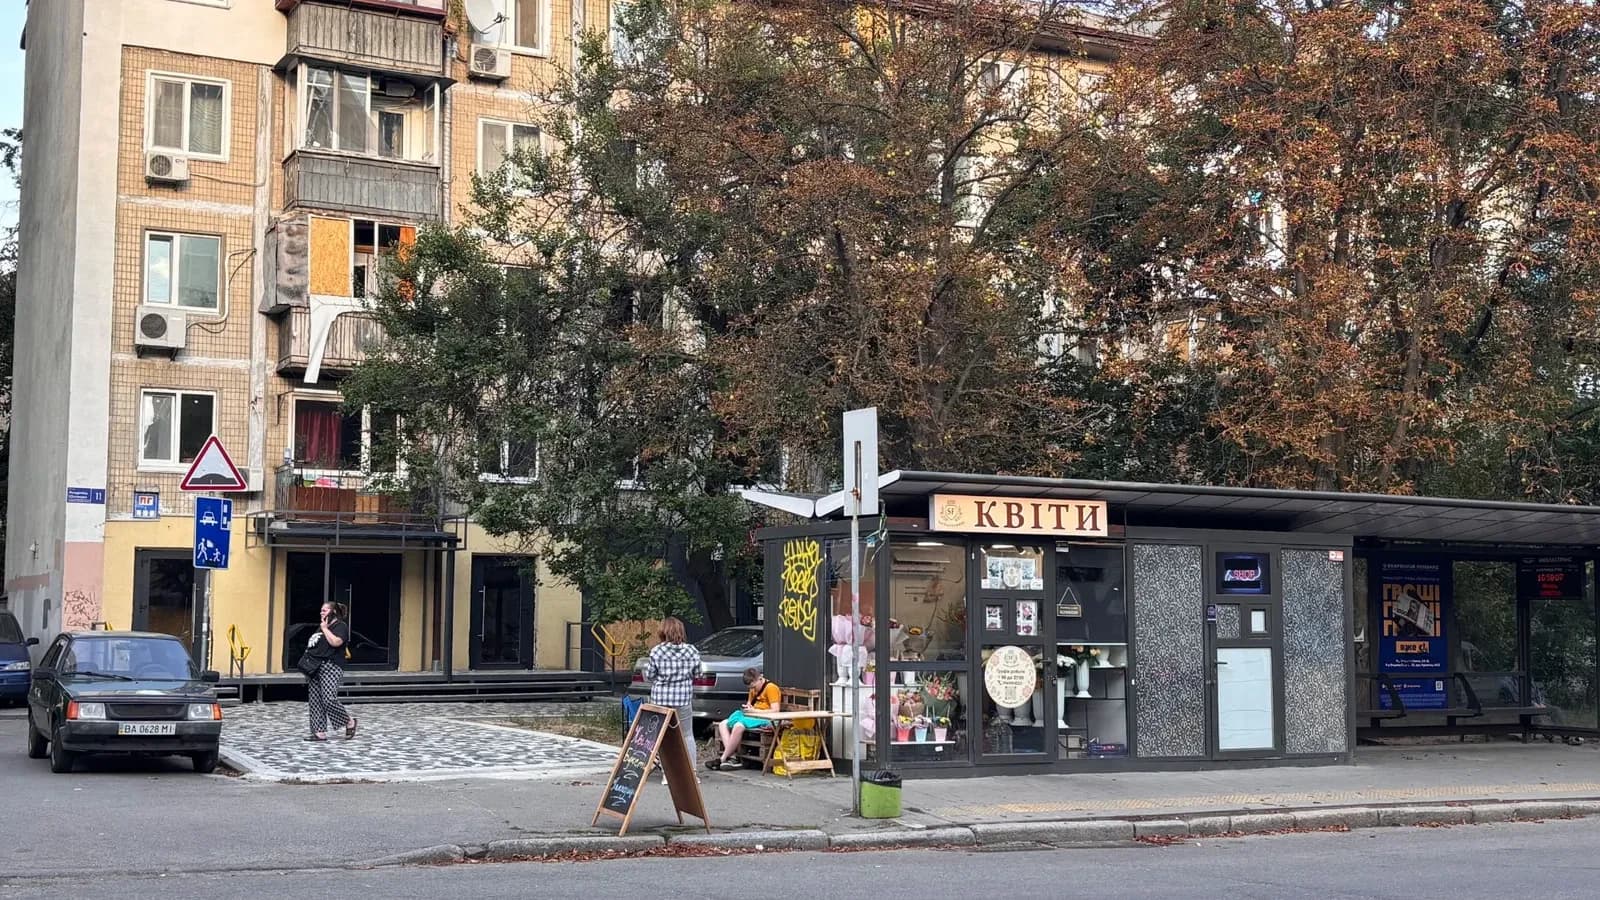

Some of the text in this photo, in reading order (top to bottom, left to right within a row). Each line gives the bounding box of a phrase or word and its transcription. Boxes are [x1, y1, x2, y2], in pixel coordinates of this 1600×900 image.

[95, 492, 102, 500] 11
[974, 500, 1101, 531] КВІТИ
[1233, 569, 1255, 578] SHOP
[125, 724, 137, 733] BA
[140, 725, 160, 733] 0628
